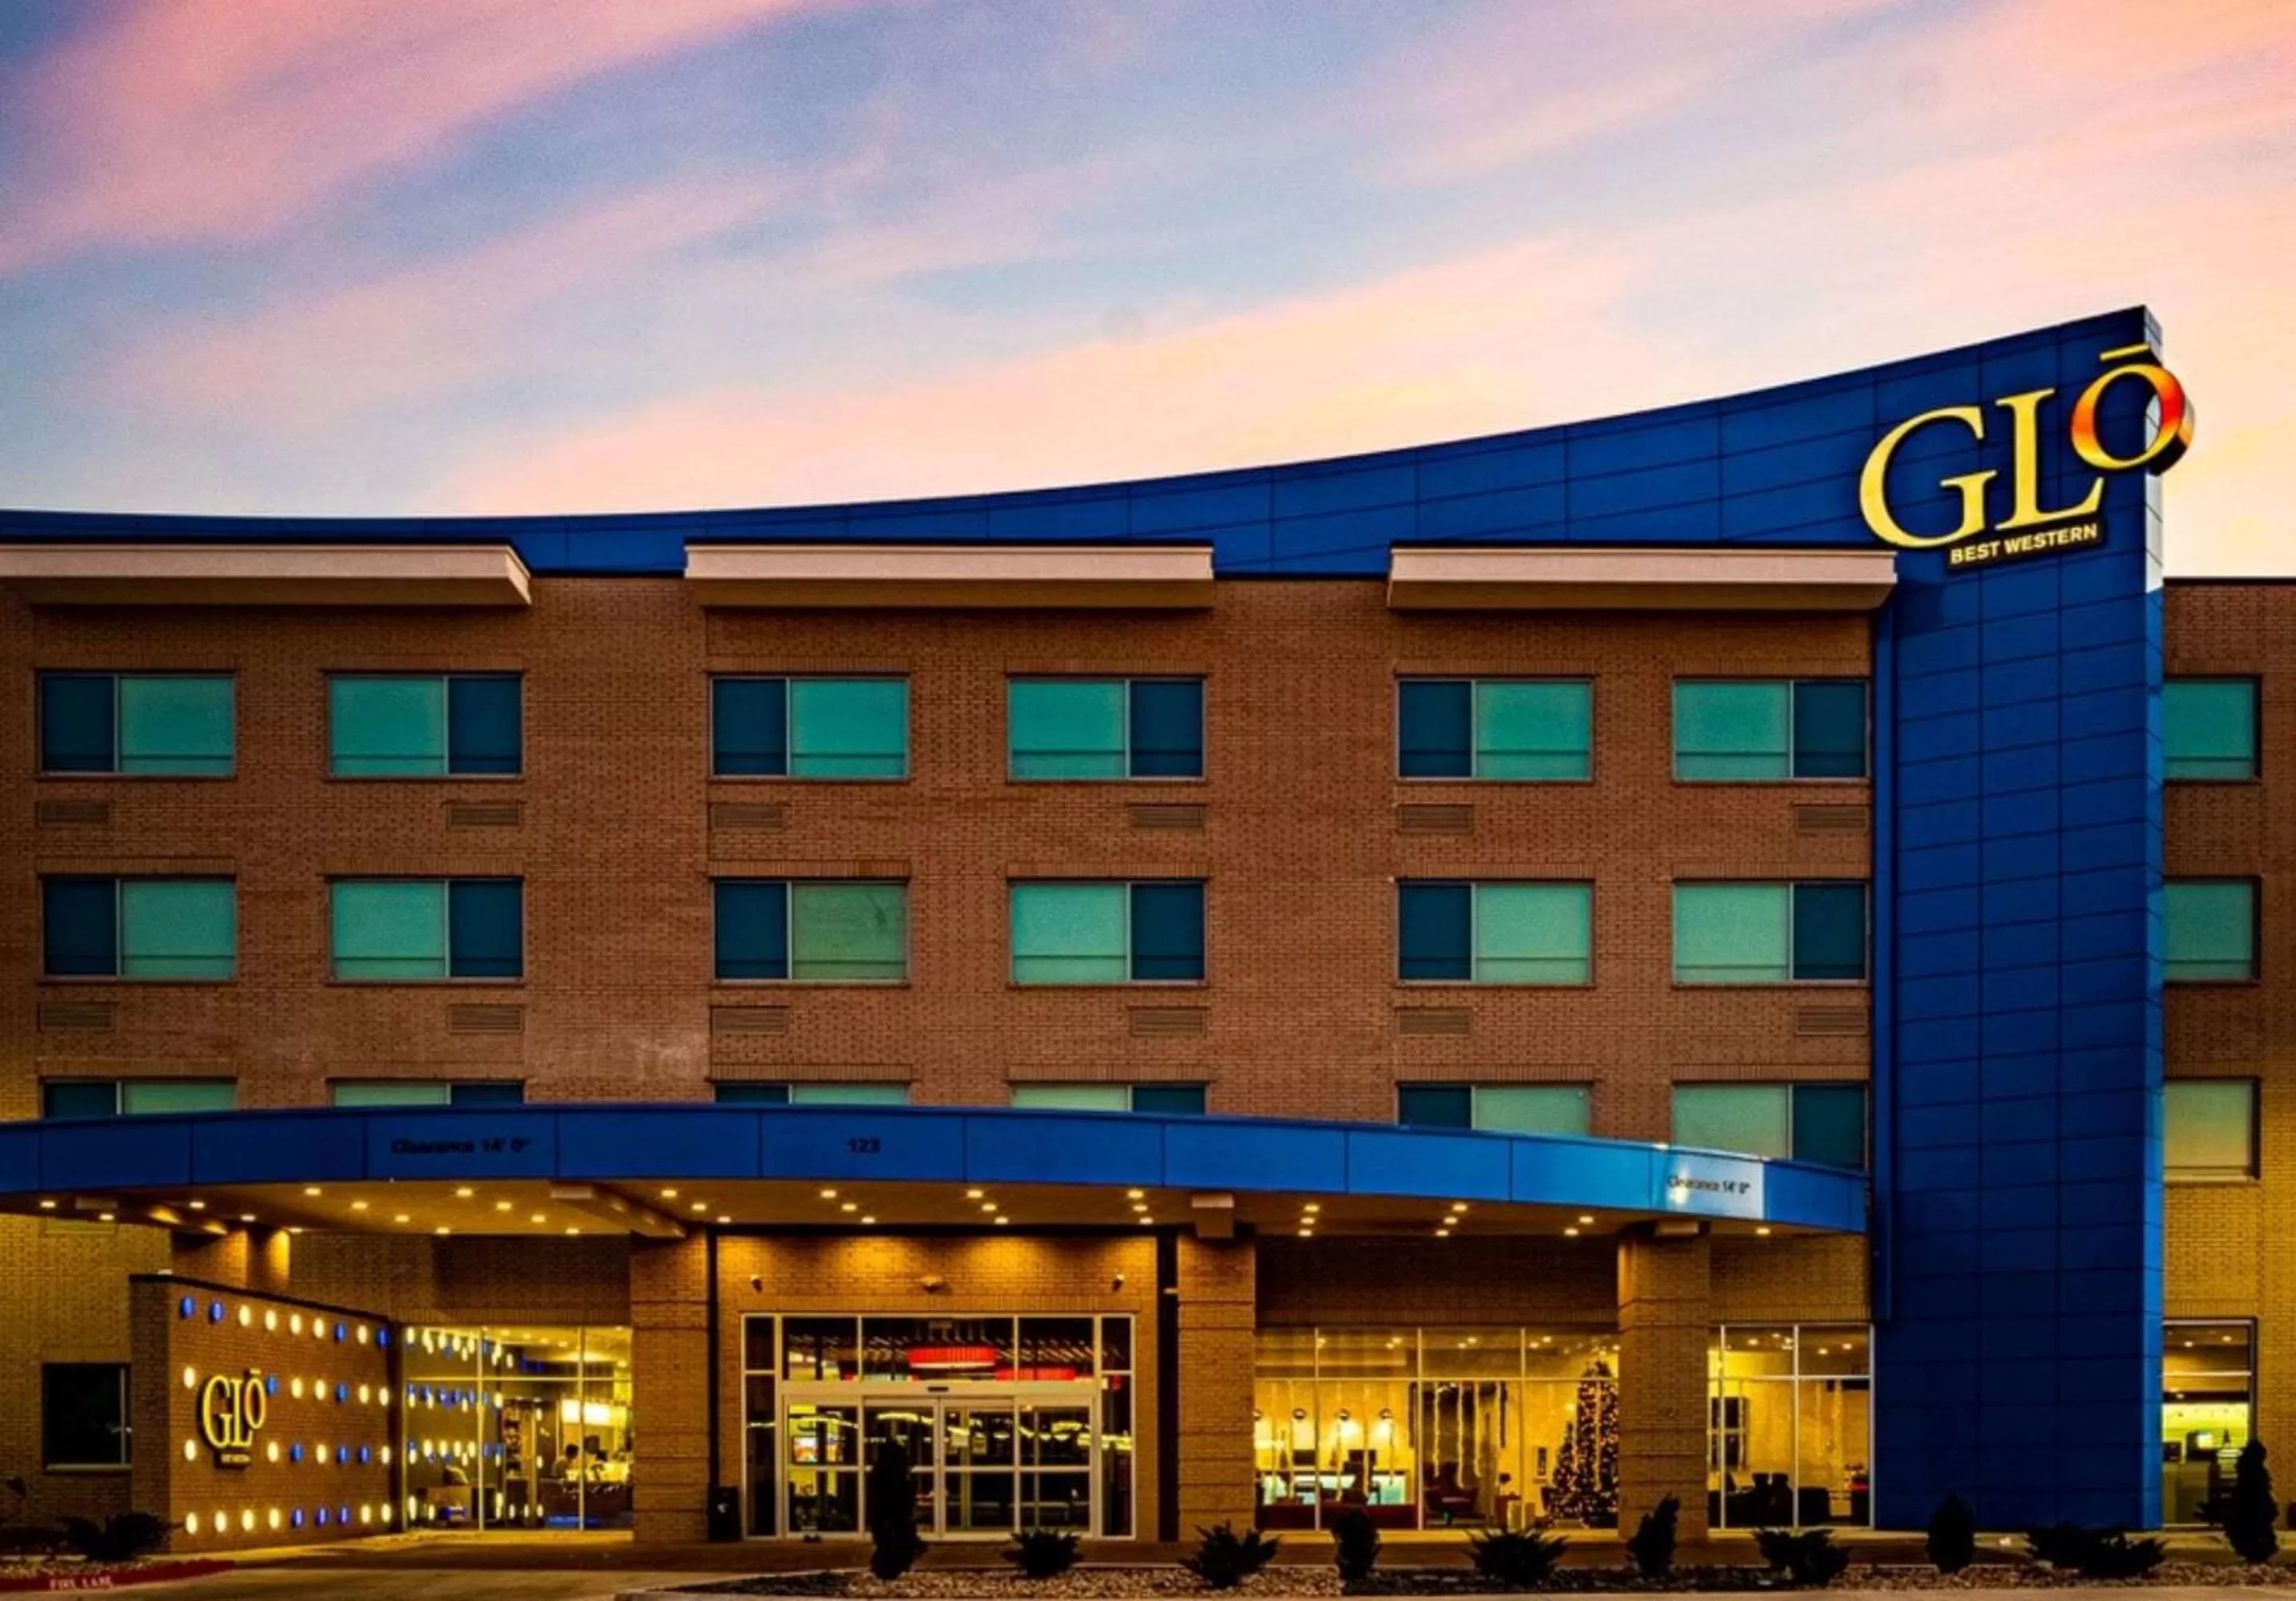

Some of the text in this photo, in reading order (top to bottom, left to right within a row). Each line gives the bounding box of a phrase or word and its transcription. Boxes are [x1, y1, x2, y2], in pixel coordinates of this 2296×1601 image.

[1951, 523, 2097, 564] BEST WESTERN
[391, 1139, 475, 1155] Clearance
[847, 1138, 882, 1154] 123
